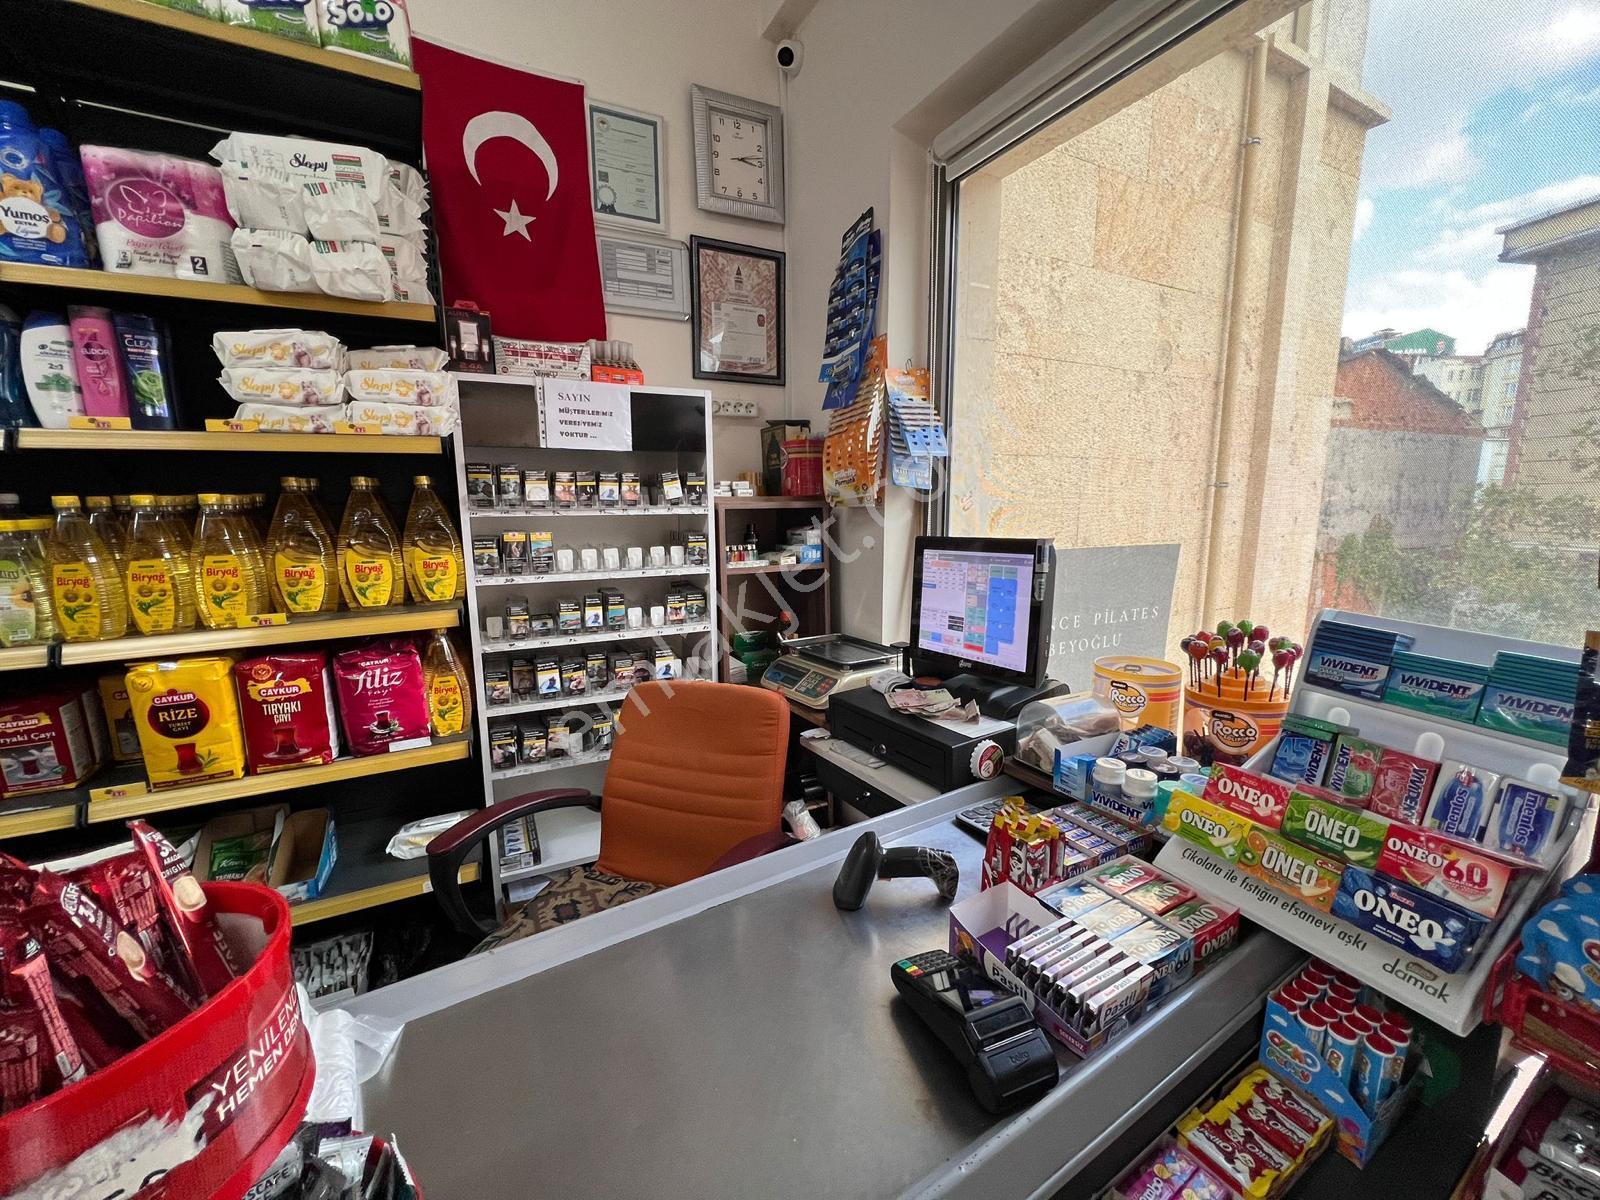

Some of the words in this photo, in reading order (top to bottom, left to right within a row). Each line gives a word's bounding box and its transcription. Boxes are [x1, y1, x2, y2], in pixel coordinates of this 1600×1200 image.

[289, 153, 328, 172] Sleepy
[194, 258, 204, 270] 2
[124, 338, 157, 348] CLEA
[557, 392, 591, 402] SAYIN
[206, 567, 239, 579] Biryağ
[284, 568, 316, 580] Biryağ
[354, 564, 384, 575] Biryağ
[422, 560, 449, 571] Biryağ
[56, 576, 90, 589] Biryağ
[131, 573, 165, 585] Biryağ
[353, 667, 403, 696] filiz
[0, 732, 28, 746] ryaki
[1218, 778, 1276, 808] ONEO
[1181, 809, 1227, 838] ONEO
[1304, 810, 1360, 848] ONEO
[1261, 846, 1319, 887] ONEO
[1387, 838, 1443, 868] ONEO
[1443, 860, 1489, 890] 60
[1182, 847, 1222, 876] Çikolata
[1224, 869, 1238, 884] ile
[1281, 902, 1335, 935] efsanevi
[1337, 929, 1368, 951] aşkı
[1354, 889, 1443, 941] ONEO
[1150, 961, 1176, 985] NEO
[1382, 958, 1450, 1004] damak
[216, 1043, 282, 1122] HEMEN
